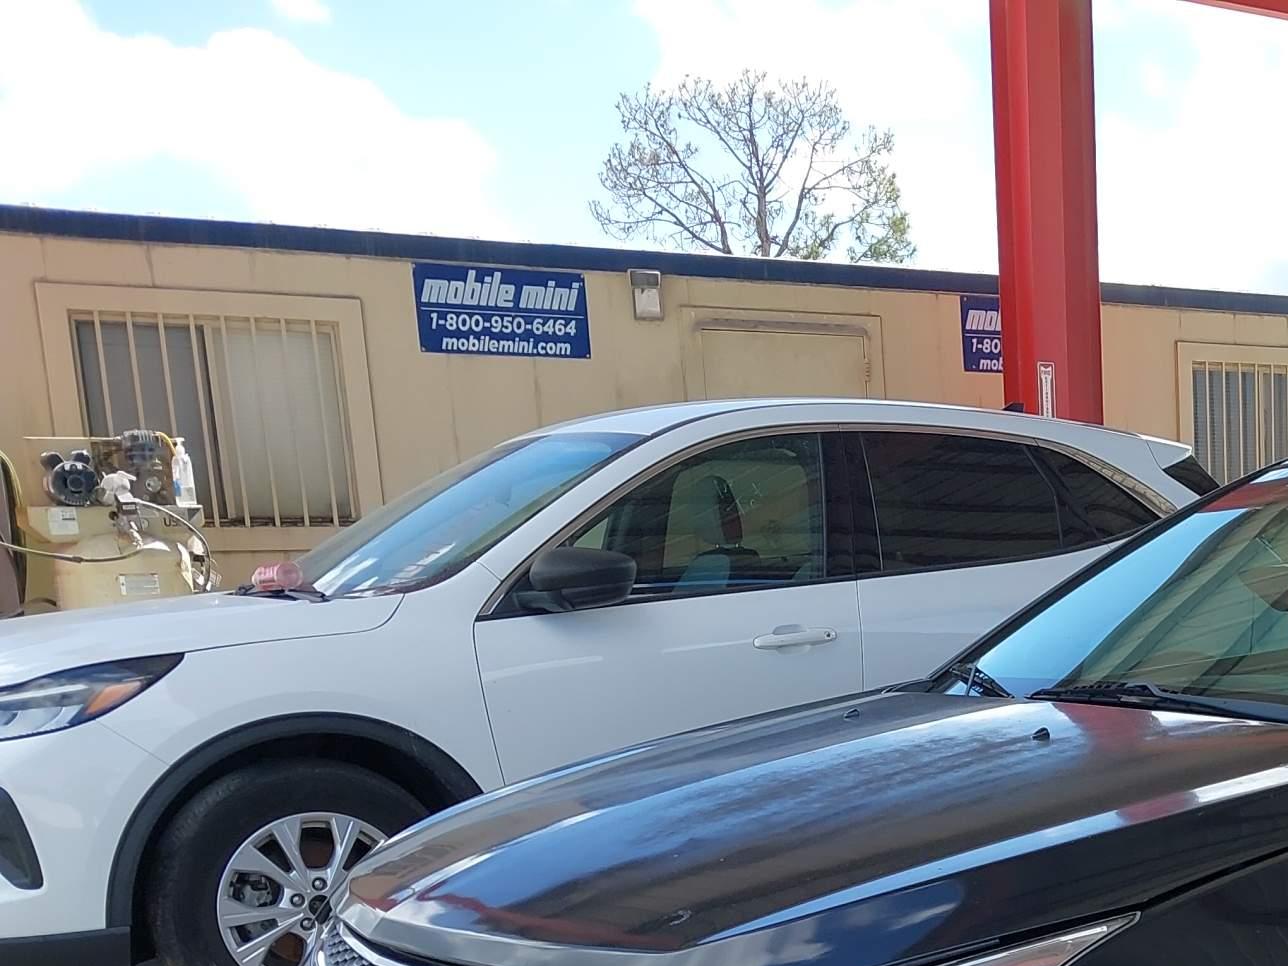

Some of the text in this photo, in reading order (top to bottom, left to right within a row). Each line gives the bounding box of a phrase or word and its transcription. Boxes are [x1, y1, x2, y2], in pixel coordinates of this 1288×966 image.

[421, 270, 579, 311] mobile mini
[430, 312, 577, 336] 1-800-950-6464
[441, 335, 571, 355] mobilemini.com
